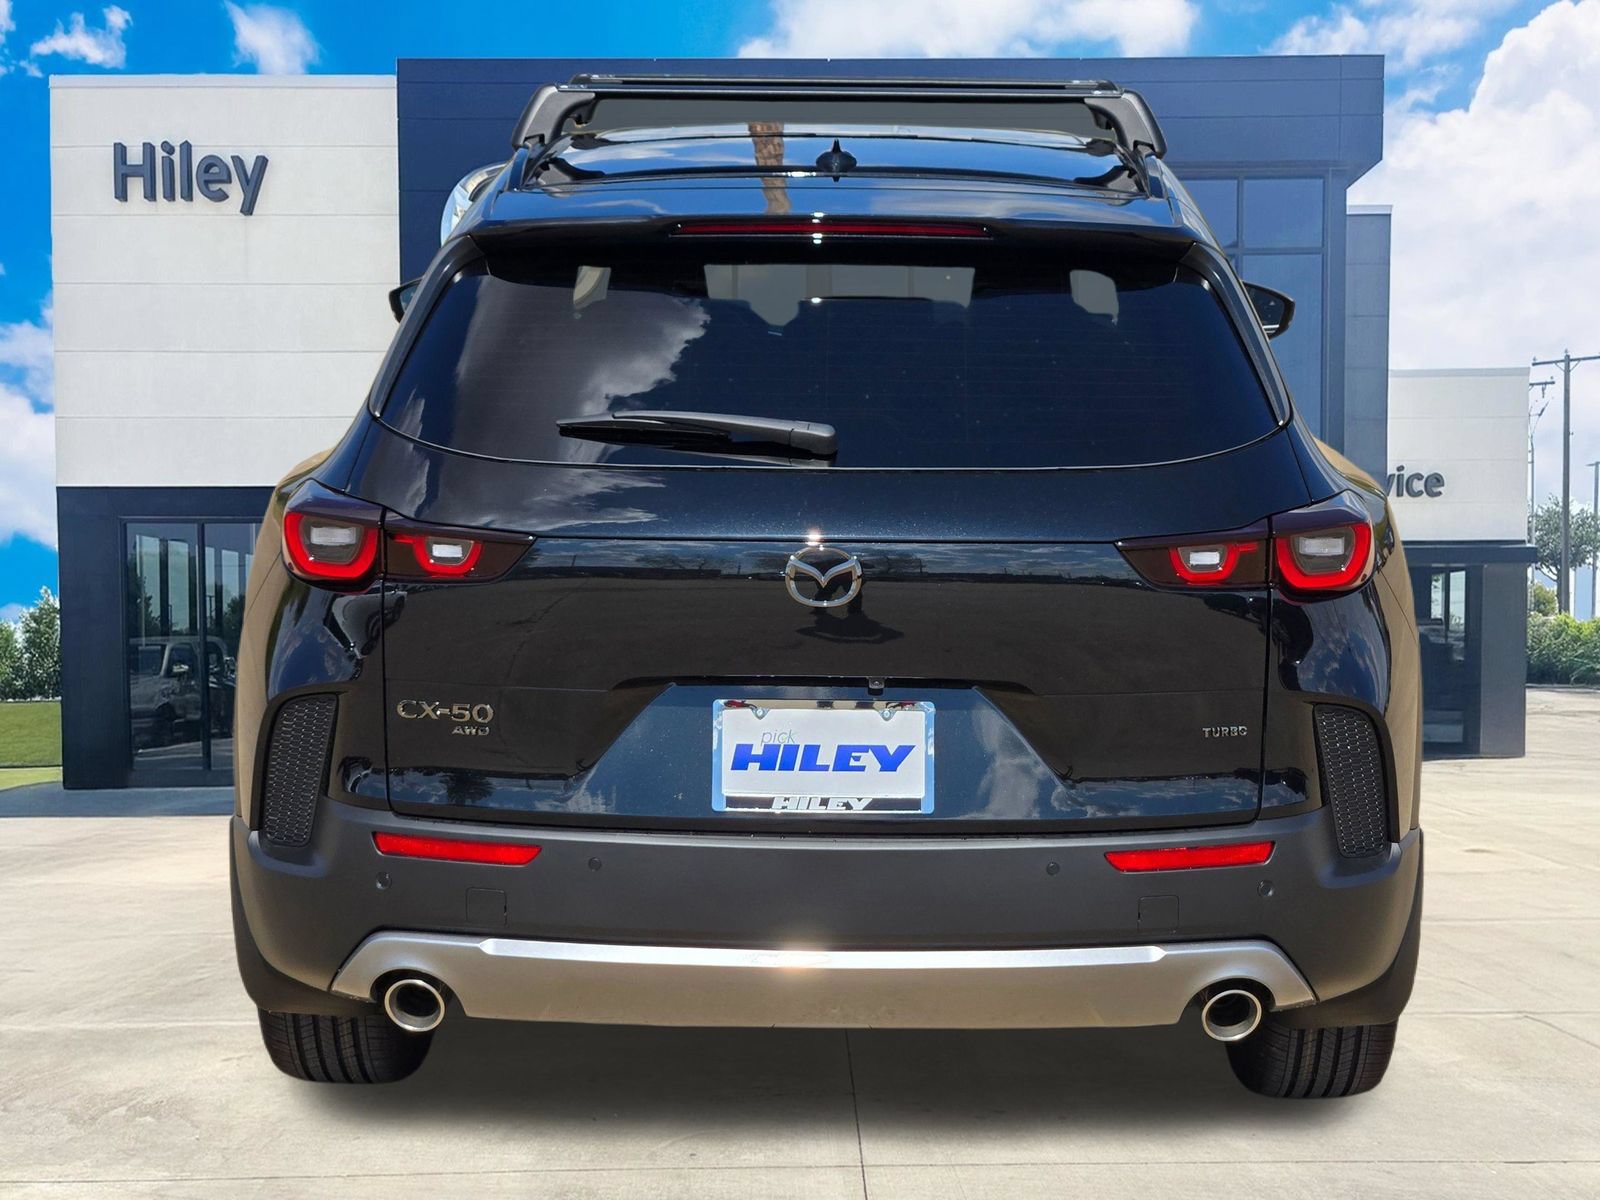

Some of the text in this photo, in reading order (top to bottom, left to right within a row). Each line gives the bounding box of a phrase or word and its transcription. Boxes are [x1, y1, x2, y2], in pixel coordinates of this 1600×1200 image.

[113, 140, 269, 216] Hiley
[396, 699, 494, 723] CX-50
[451, 725, 490, 736] AWD
[761, 729, 796, 746] pick
[1202, 725, 1248, 738] TURBO
[730, 743, 916, 772] HILEY
[771, 796, 873, 811] HILEY
